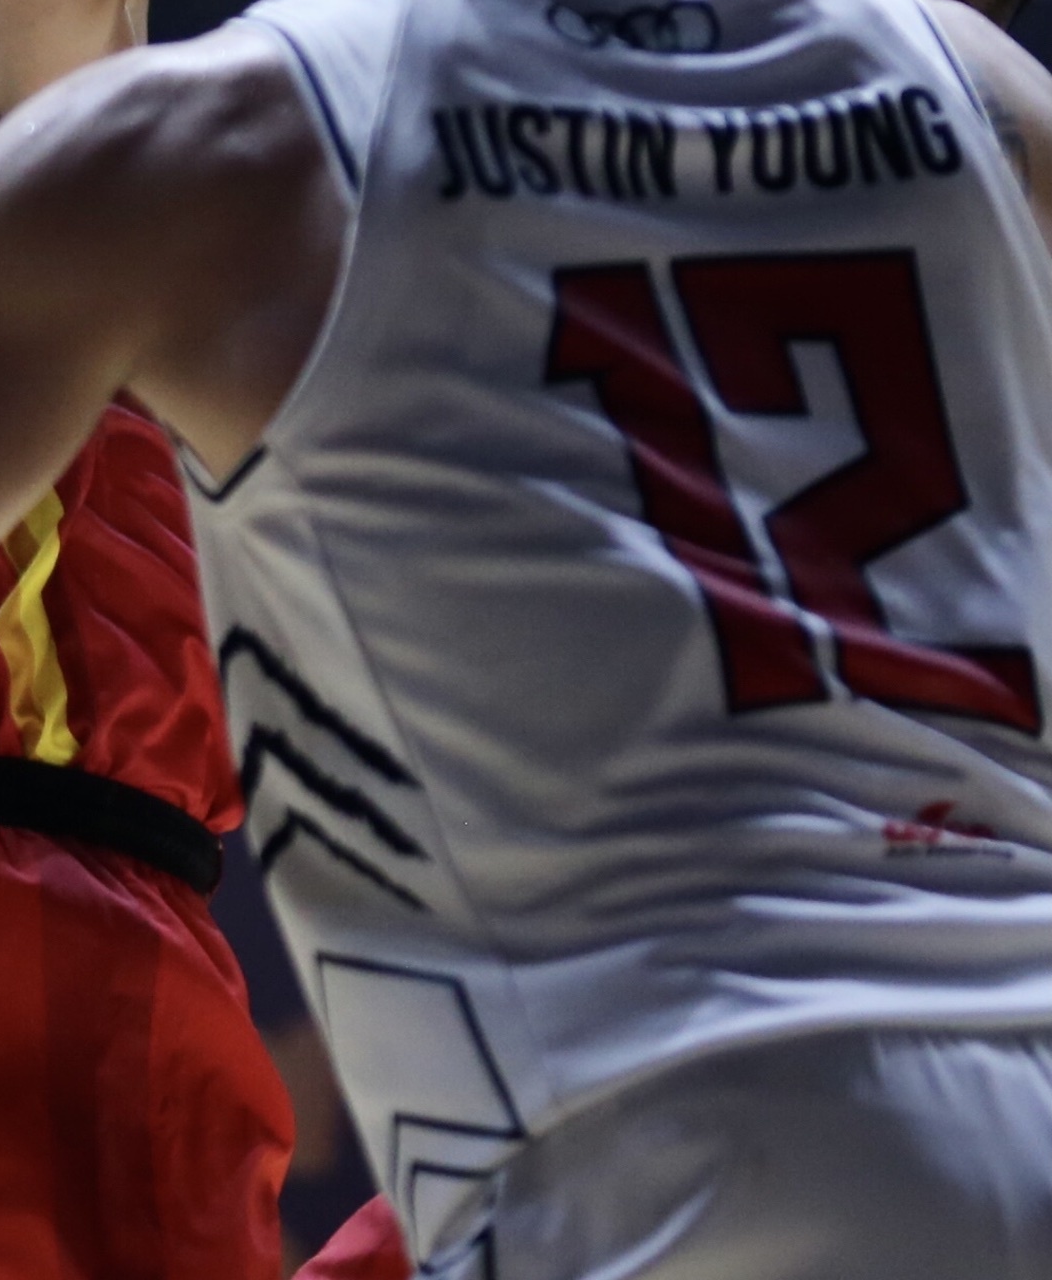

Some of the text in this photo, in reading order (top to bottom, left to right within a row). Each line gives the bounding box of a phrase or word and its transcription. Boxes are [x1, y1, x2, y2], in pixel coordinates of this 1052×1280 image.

[433, 86, 963, 200] JUSTIN YOUNG
[544, 249, 1040, 738] 12
